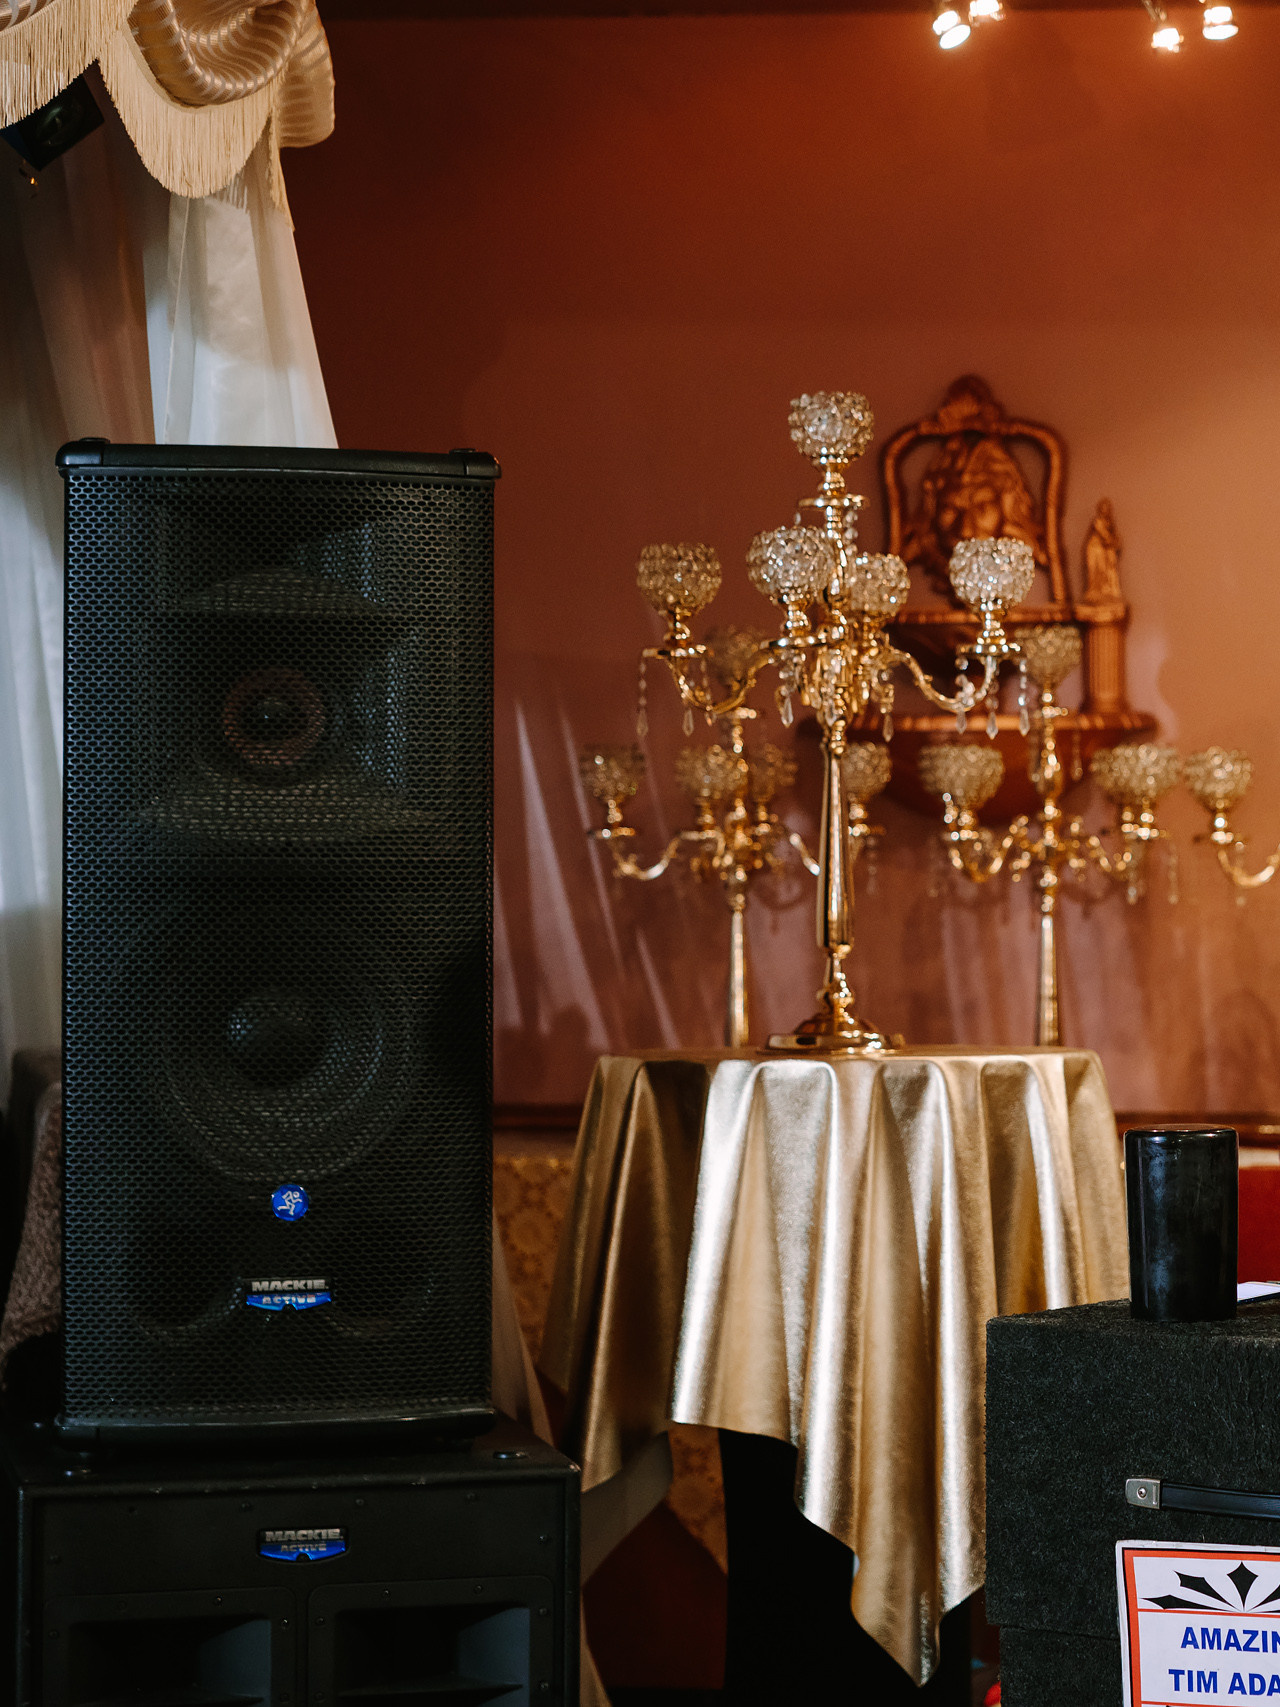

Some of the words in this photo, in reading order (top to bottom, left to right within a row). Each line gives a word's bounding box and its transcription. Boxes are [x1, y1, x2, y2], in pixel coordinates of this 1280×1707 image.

[262, 1294, 317, 1305] ACTIVE
[281, 1543, 327, 1552] ACTIVE
[1168, 1668, 1218, 1694] TIM
